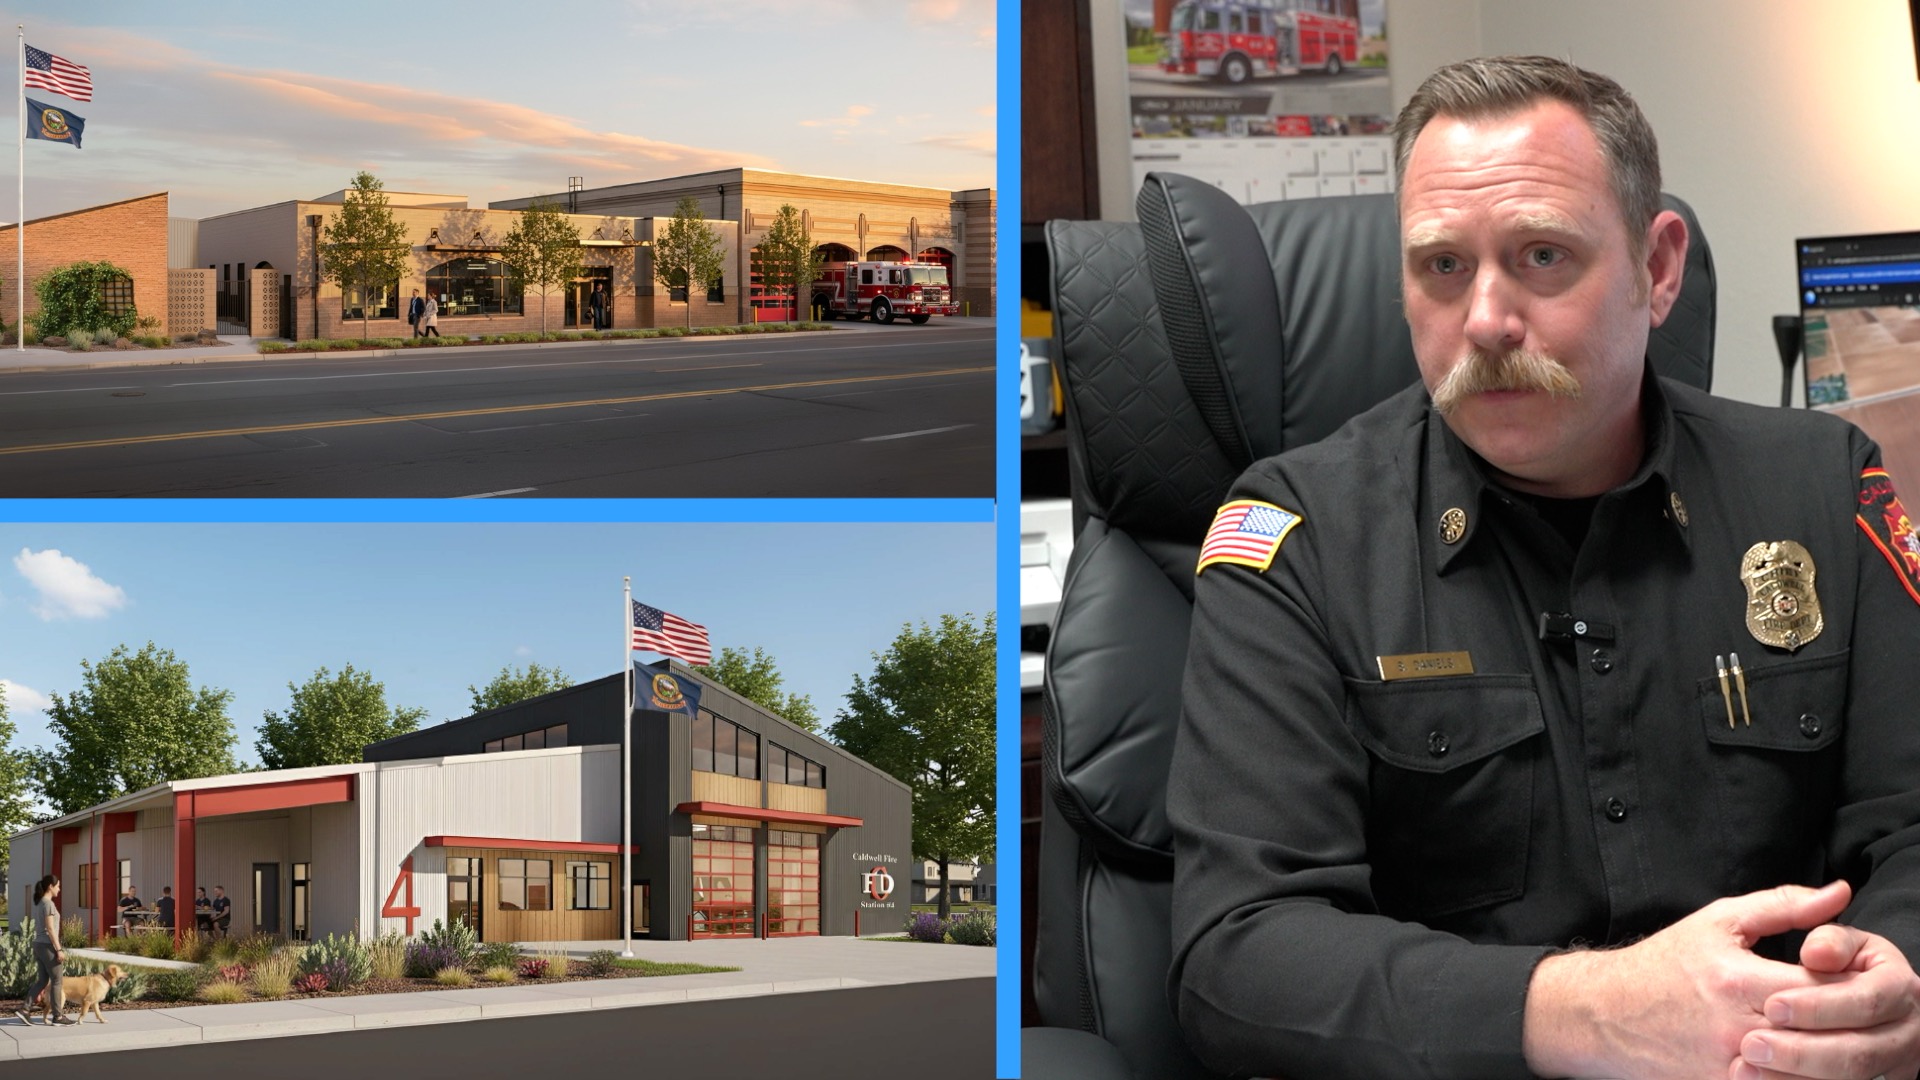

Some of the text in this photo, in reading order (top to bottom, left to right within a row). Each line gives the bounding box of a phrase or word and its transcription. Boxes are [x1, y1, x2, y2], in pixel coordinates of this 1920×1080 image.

[1171, 98, 1244, 112] JANUARY
[1761, 567, 1800, 581] CHIEF
[1760, 580, 1805, 597] CALDWELL
[1763, 618, 1786, 630] FIRE
[1413, 657, 1454, 672] DANIELS
[852, 852, 898, 863] Caldwell Fire
[381, 855, 421, 935] 4
